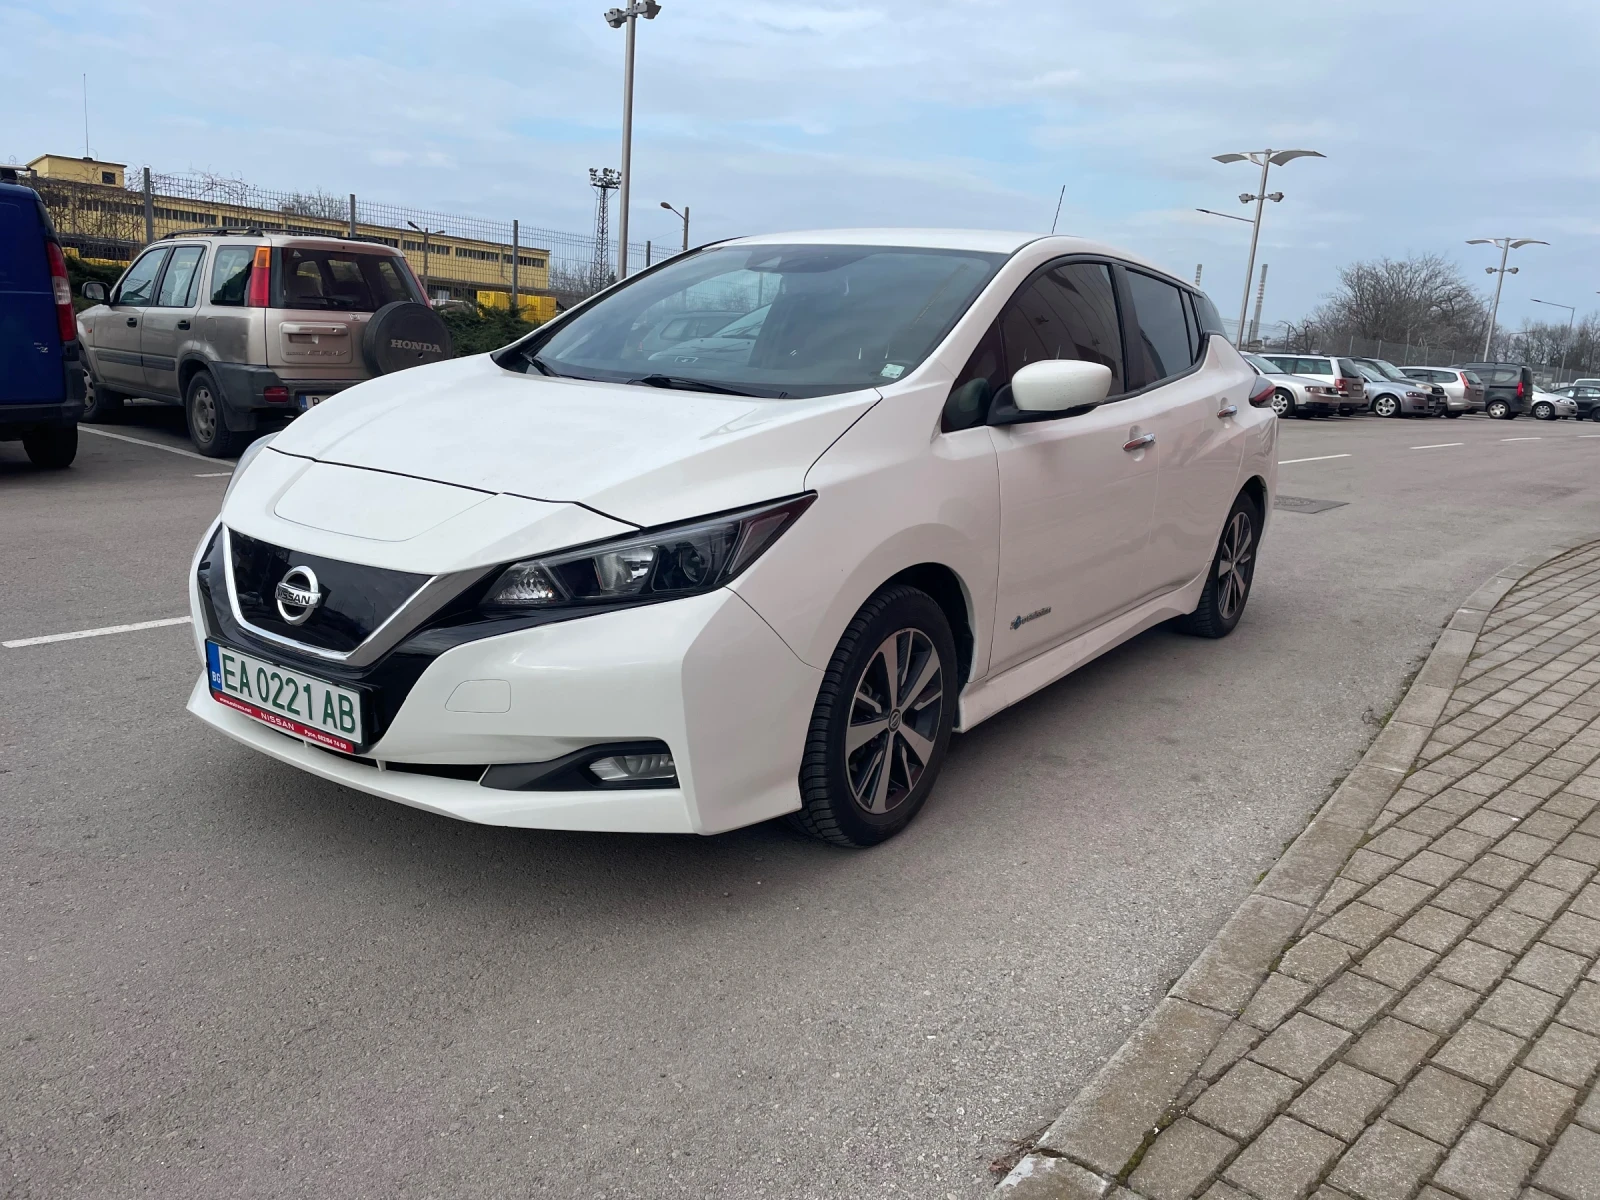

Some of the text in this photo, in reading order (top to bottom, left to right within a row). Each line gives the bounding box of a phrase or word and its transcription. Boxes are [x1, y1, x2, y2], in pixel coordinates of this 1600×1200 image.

[390, 339, 442, 353] HONDA
[211, 671, 221, 684] BG
[221, 653, 356, 734] EA 0221 AB
[260, 712, 295, 731] NISSAN
